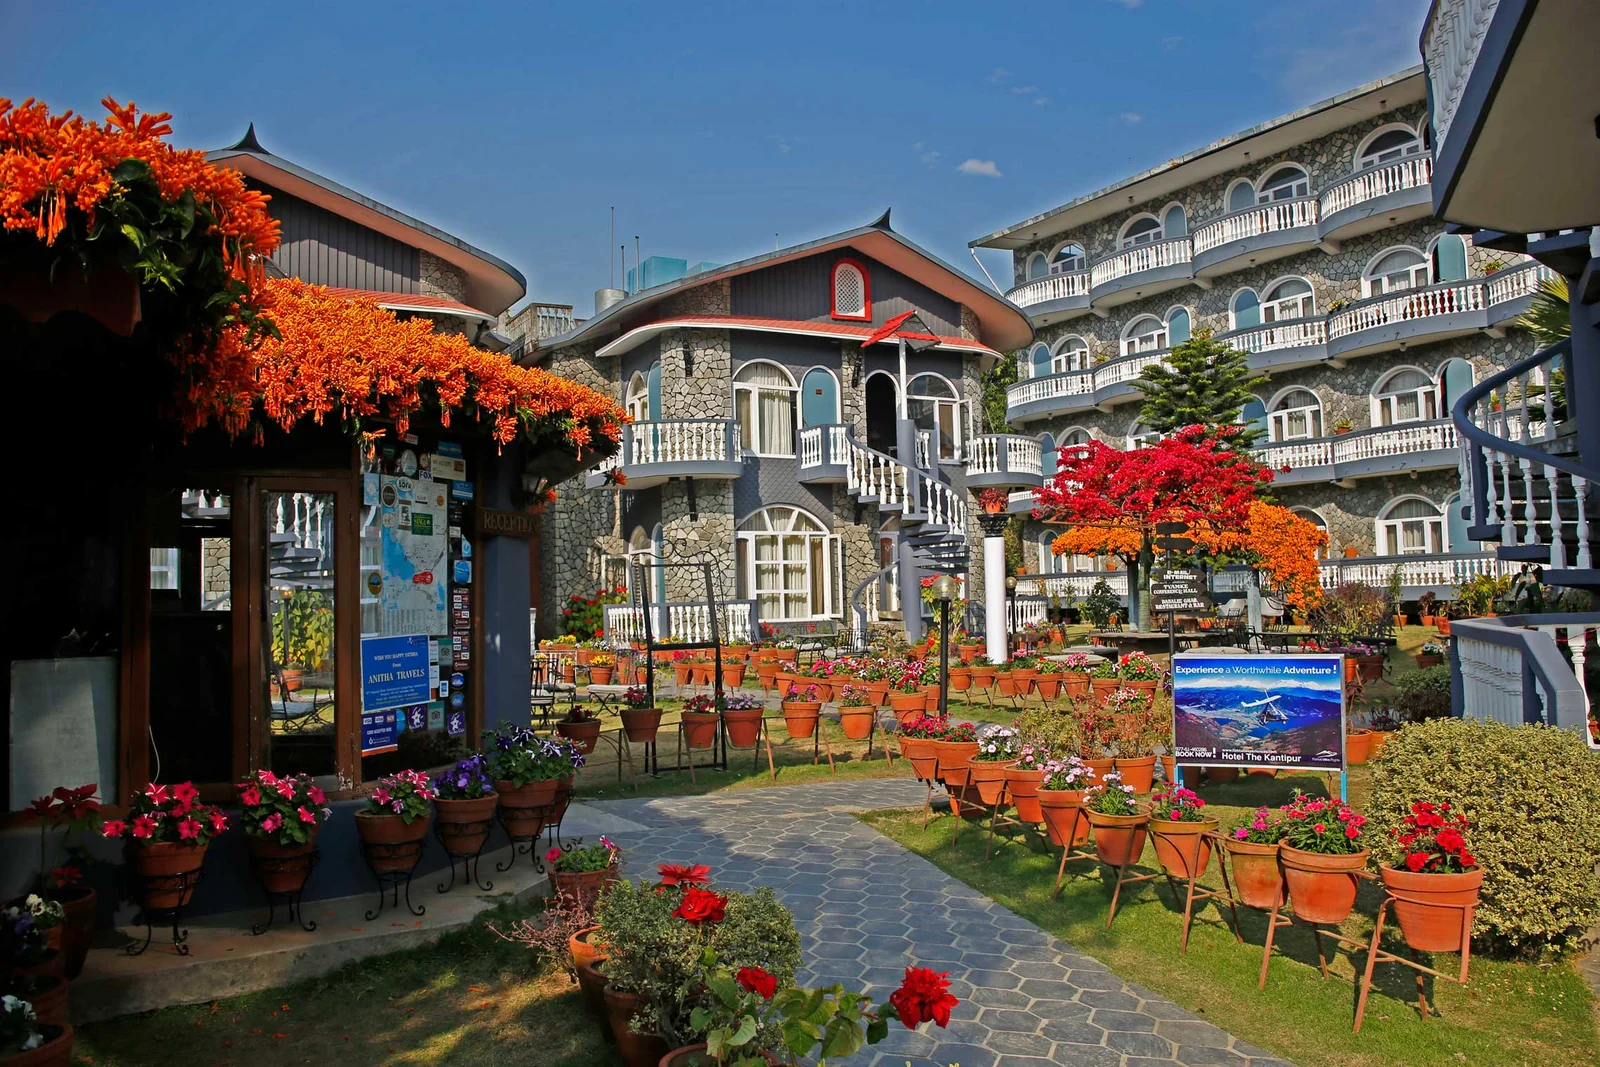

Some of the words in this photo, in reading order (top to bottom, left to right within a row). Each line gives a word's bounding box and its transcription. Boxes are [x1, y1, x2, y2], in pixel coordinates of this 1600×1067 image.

[419, 471, 432, 480] FOX
[484, 512, 538, 533] RECEPTION
[368, 672, 394, 684] ANITHA
[396, 668, 425, 680] TRAVELS
[1175, 666, 1224, 676] Experience
[1232, 666, 1282, 674] Worthwhile
[1222, 752, 1244, 760] Hotel
[1246, 753, 1262, 761] The
[1264, 754, 1301, 763] Kantipur
